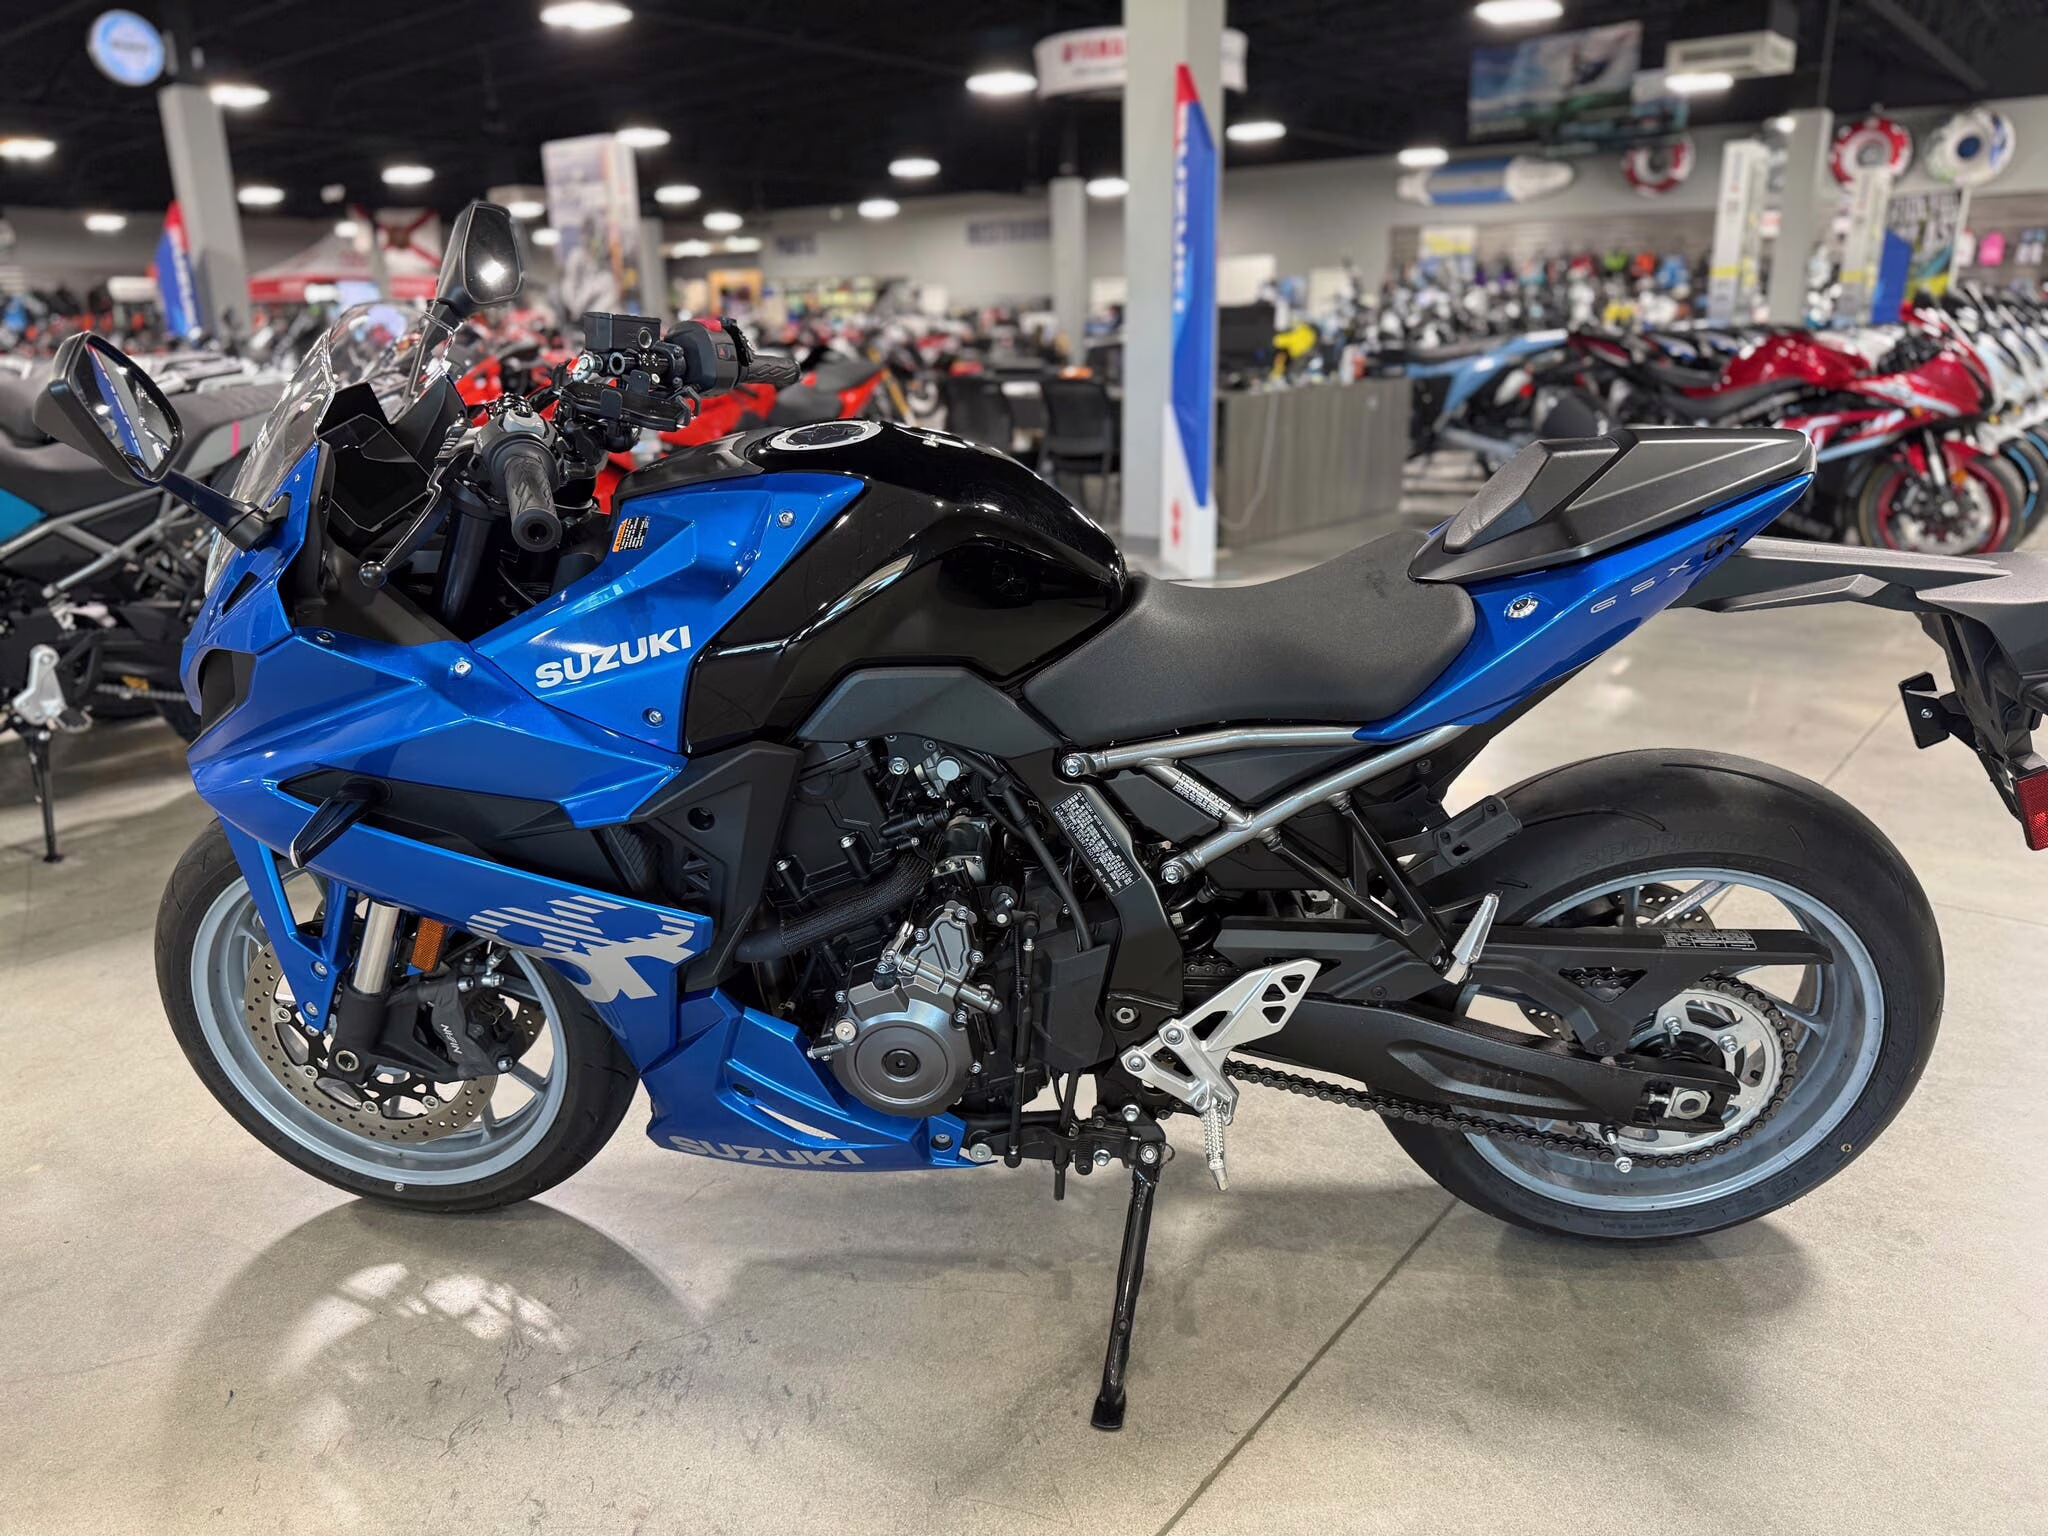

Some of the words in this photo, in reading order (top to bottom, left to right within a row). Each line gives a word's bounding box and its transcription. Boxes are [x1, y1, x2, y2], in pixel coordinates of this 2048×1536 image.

[536, 625, 691, 688] SUZUKI
[440, 1023, 463, 1054] NISSIN
[669, 1136, 865, 1165] SUZUKI
